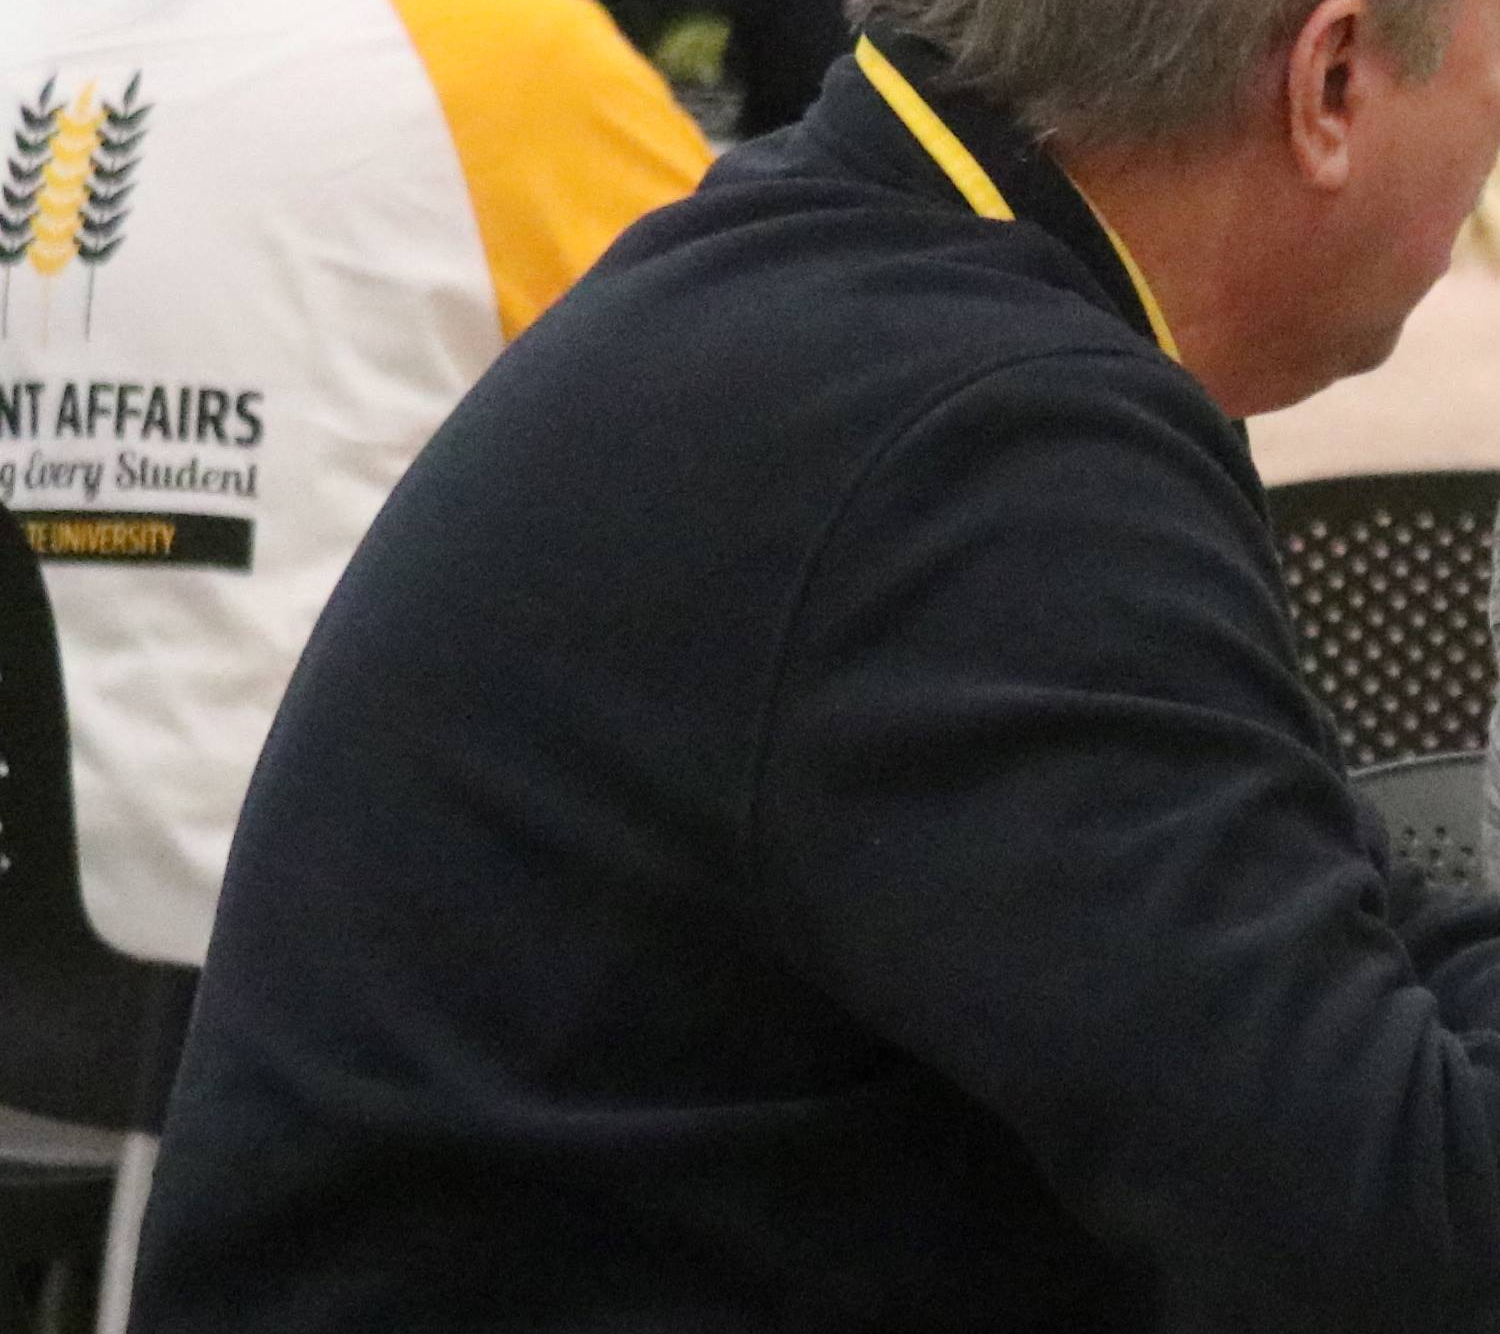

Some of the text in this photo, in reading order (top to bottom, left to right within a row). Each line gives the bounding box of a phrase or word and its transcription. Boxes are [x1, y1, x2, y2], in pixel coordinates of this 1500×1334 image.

[55, 381, 264, 447] AFFAIRS
[116, 450, 258, 499] Student
[49, 521, 176, 555] UNIVERSITY
